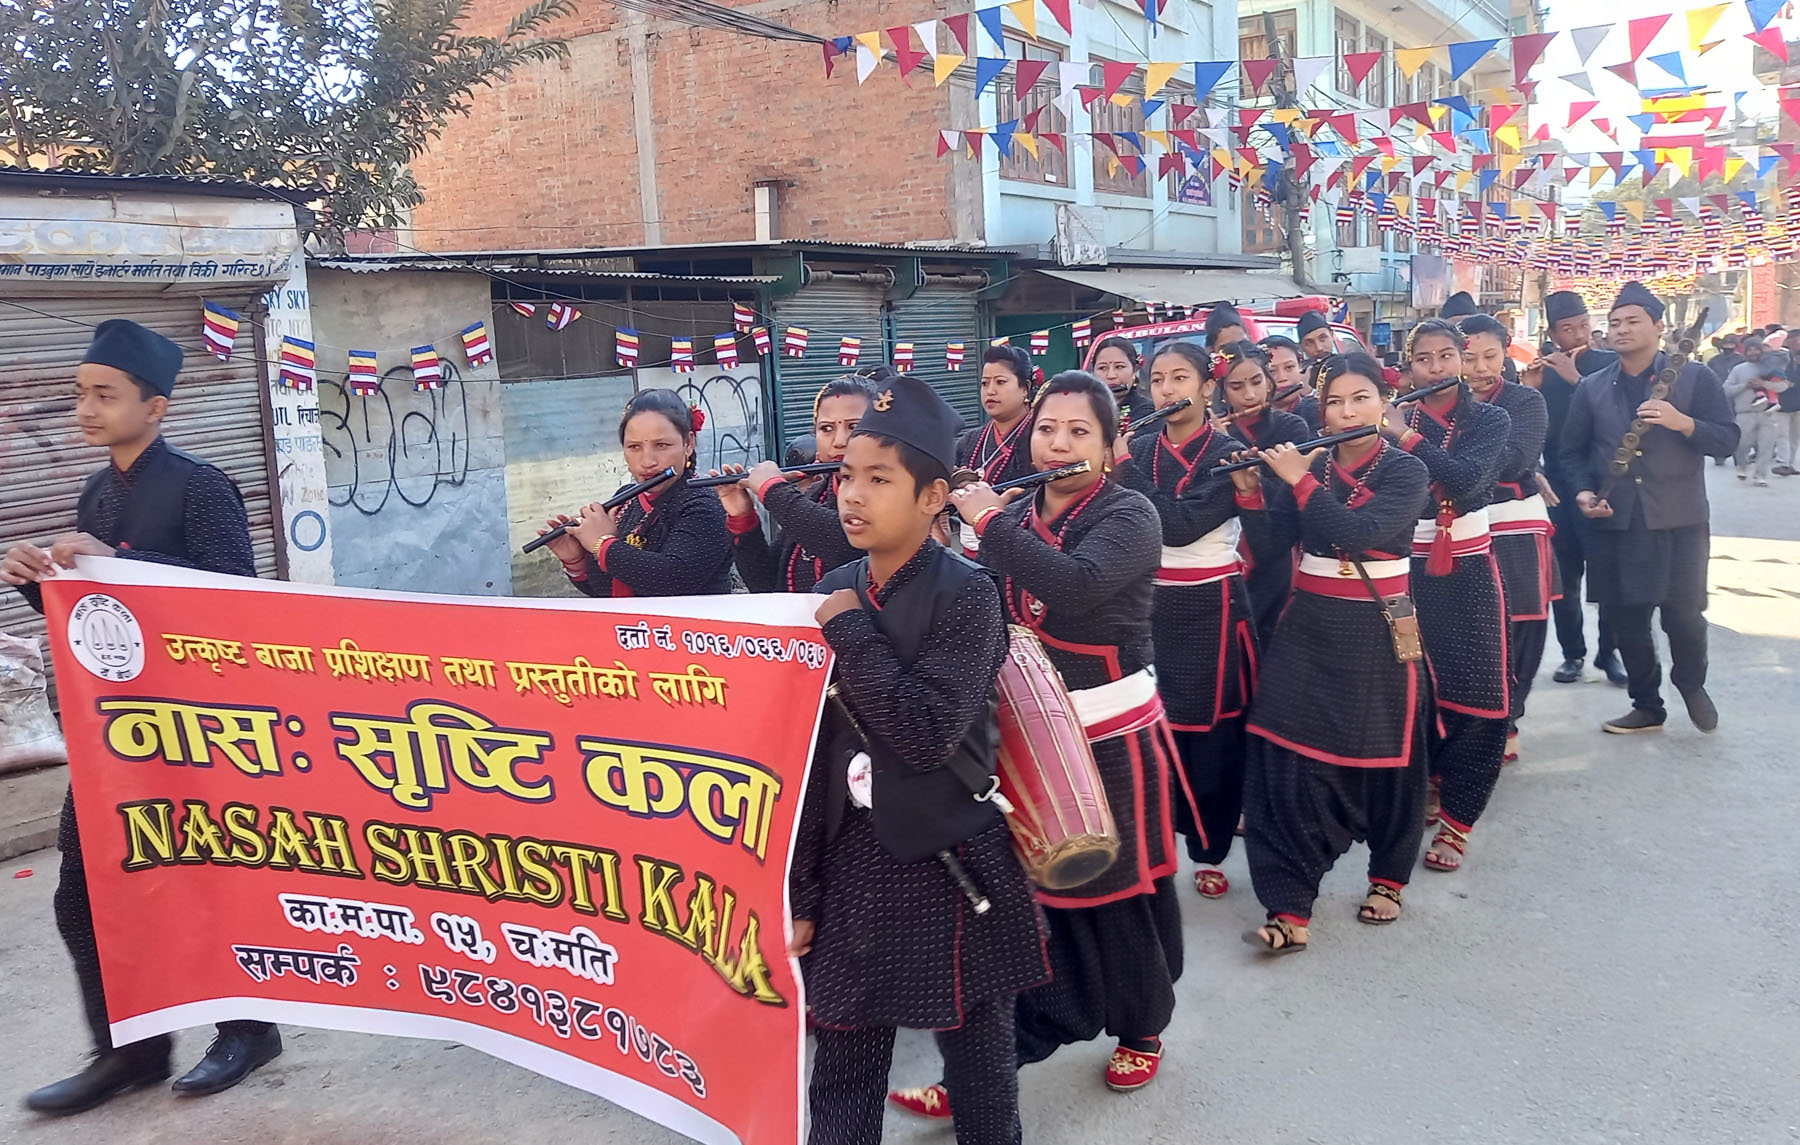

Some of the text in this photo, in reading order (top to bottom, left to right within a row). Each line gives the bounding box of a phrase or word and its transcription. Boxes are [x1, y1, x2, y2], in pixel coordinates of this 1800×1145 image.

[287, 290, 306, 309] SKY
[1104, 322, 1206, 339] AMBULAN
[617, 623, 649, 648] दर्ता
[161, 633, 727, 707] उत्कृष्ट बाजा प्रशिक्षण तथा प्रस्तुतीको लागि
[331, 698, 554, 810] सृष्टि
[577, 736, 782, 862] कला
[119, 799, 787, 1008] NASAH SHRISTI KALA
[284, 897, 422, 940] का.म.पा.
[233, 945, 358, 985] सम्पर्क
